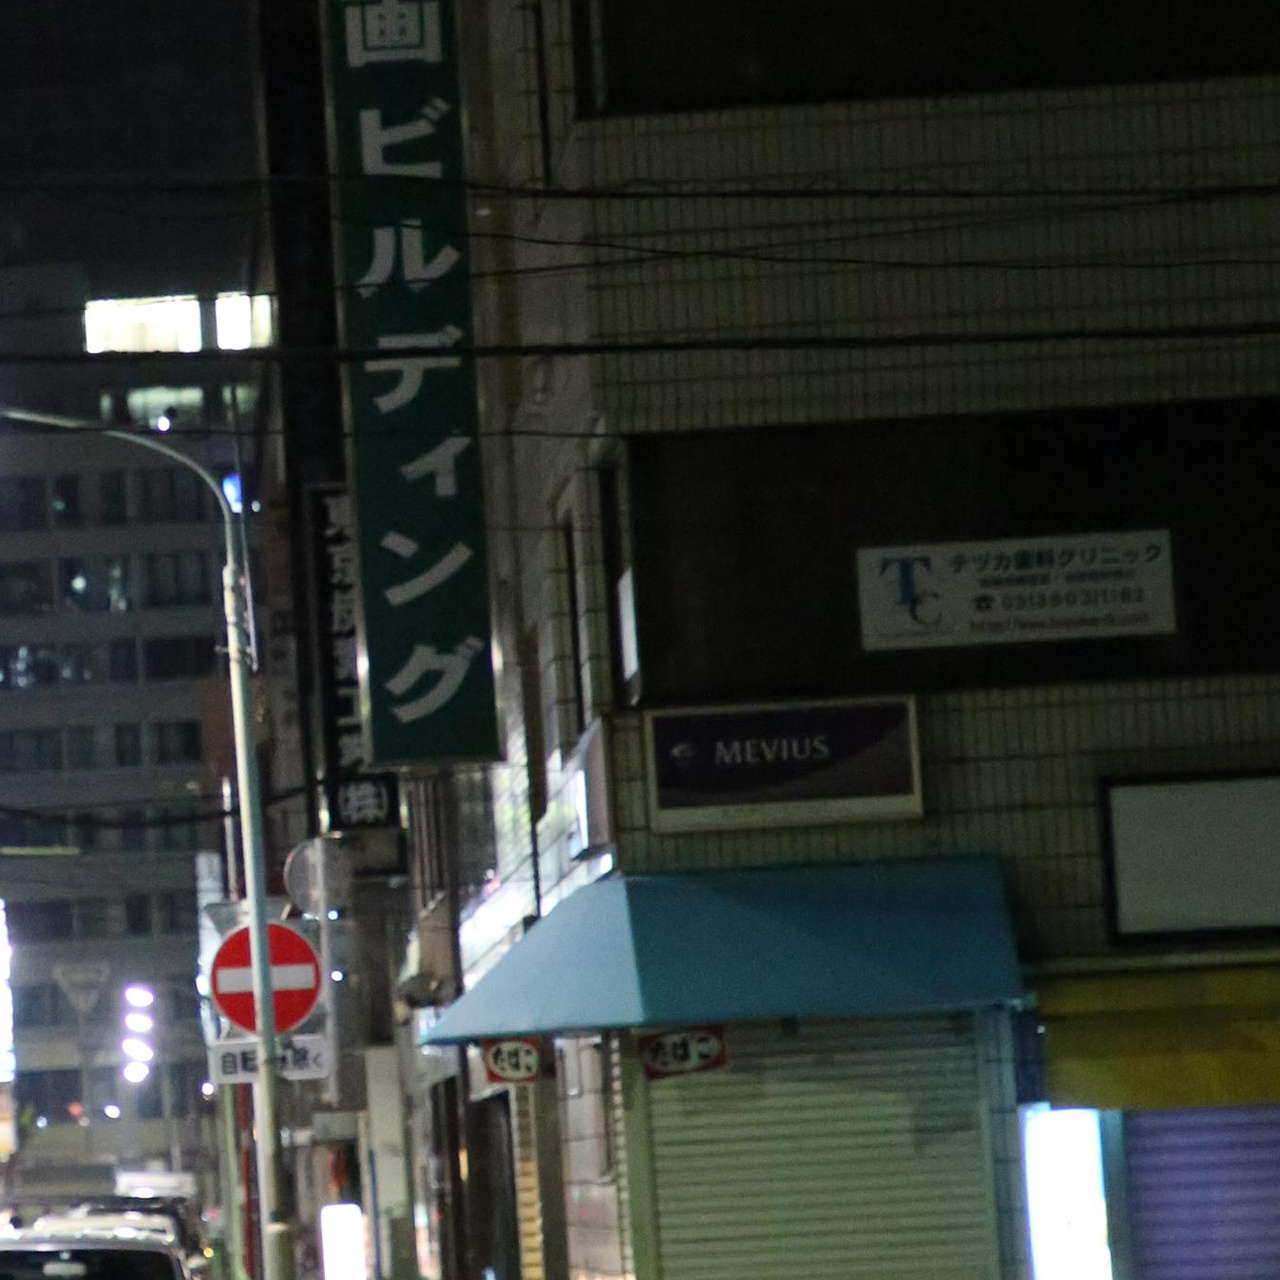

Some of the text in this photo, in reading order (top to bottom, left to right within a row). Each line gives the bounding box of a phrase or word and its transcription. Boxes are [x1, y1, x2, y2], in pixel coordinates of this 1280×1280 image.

[715, 734, 830, 765] MEVIUS
[651, 1036, 712, 1069] たばこ
